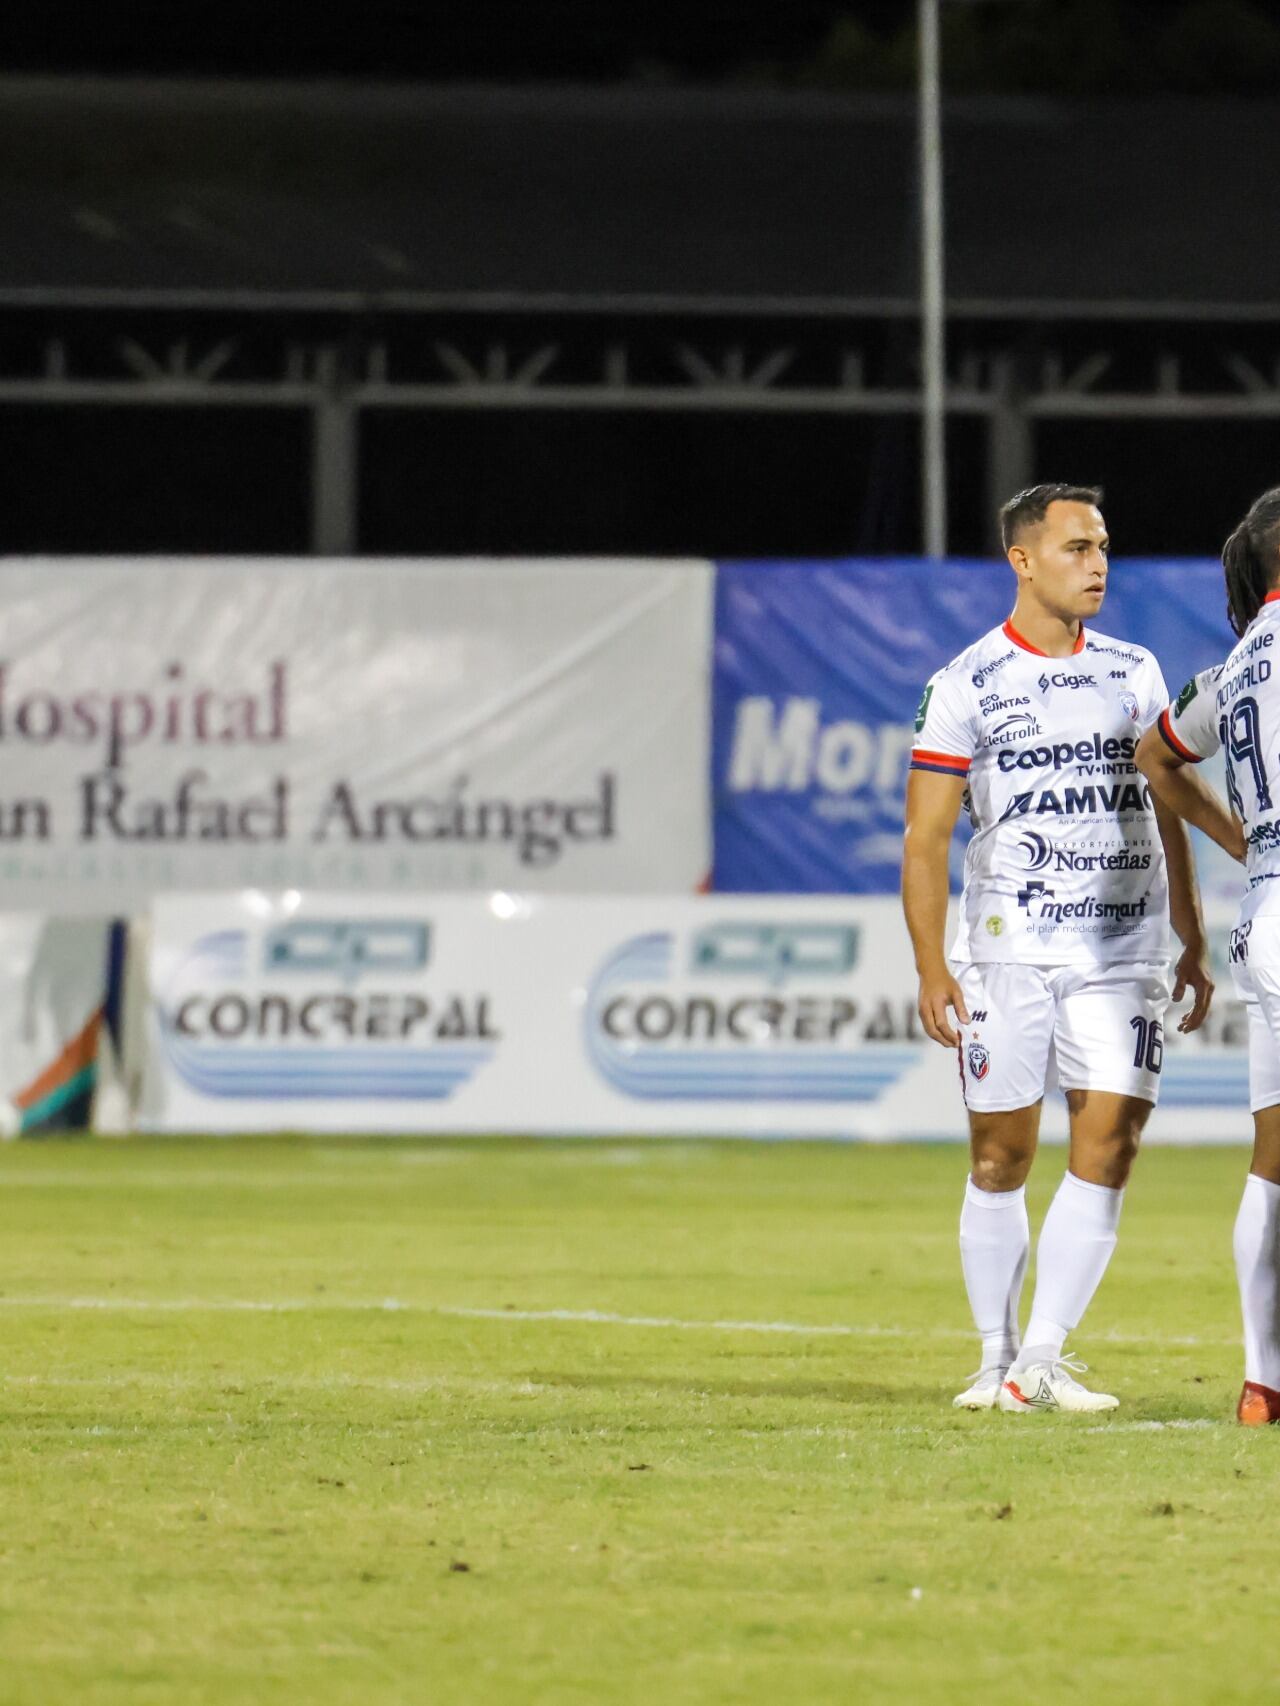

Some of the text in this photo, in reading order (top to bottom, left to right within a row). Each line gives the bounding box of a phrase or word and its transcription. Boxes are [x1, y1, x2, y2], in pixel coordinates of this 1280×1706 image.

[1052, 673, 1098, 689] Cigac
[0, 661, 288, 768] ospital
[980, 693, 1000, 707] ECO
[982, 696, 1031, 717] QUINTAS
[996, 733, 1140, 771] coopeles
[80, 774, 288, 842] Rafael
[309, 771, 616, 867] Arcángel
[1054, 850, 1151, 872] Norteñas
[1040, 895, 1147, 924] medismart
[1026, 923, 1036, 933] el
[1038, 924, 1060, 935] plan
[174, 993, 503, 1041] CONCREPAL
[1129, 1015, 1164, 1075] 16
